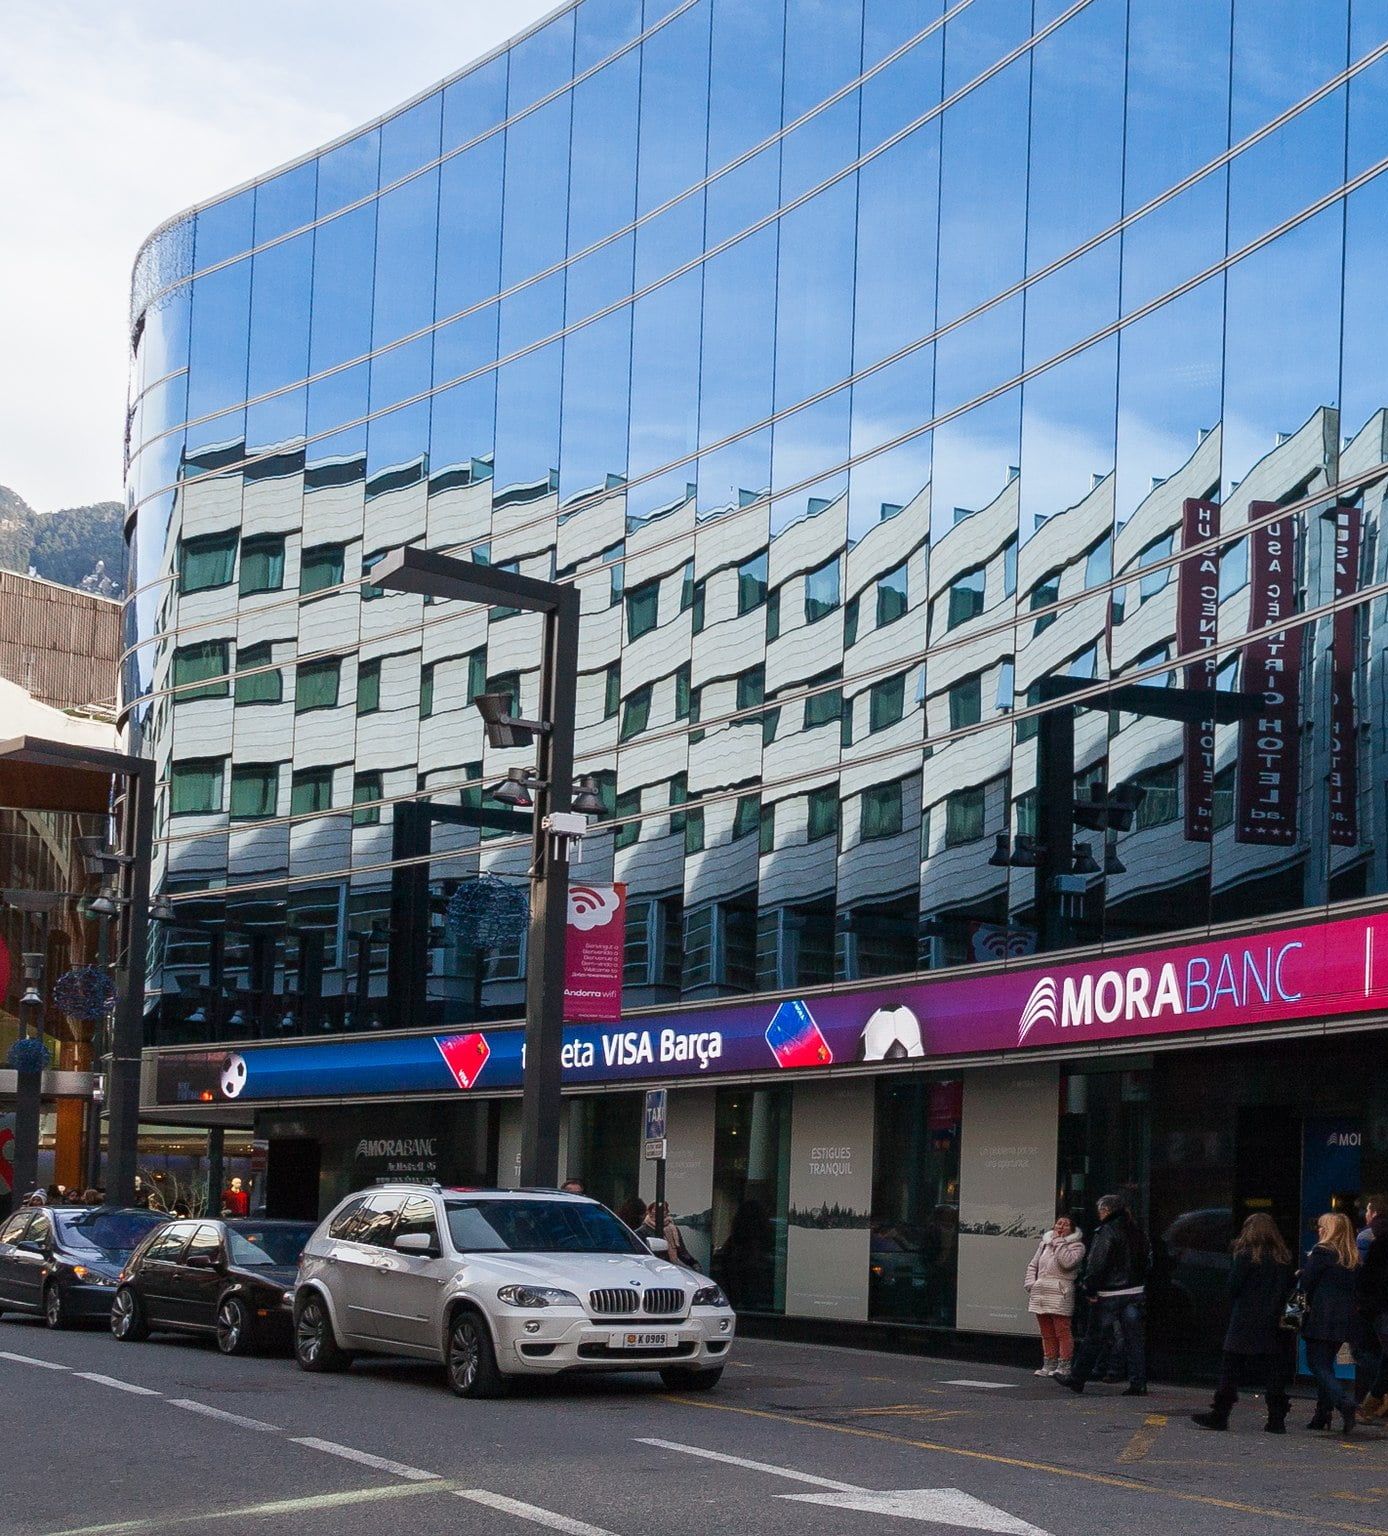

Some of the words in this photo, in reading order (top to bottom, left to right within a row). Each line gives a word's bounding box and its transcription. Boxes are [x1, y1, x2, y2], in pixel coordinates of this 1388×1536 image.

[1061, 942, 1303, 1027] MORABANC
[564, 989, 601, 998] Andorra
[602, 1031, 653, 1066] VISA
[660, 1028, 721, 1069] Barça
[811, 1147, 850, 1160] ESTIGUES
[809, 1163, 852, 1177] TRANQUIL
